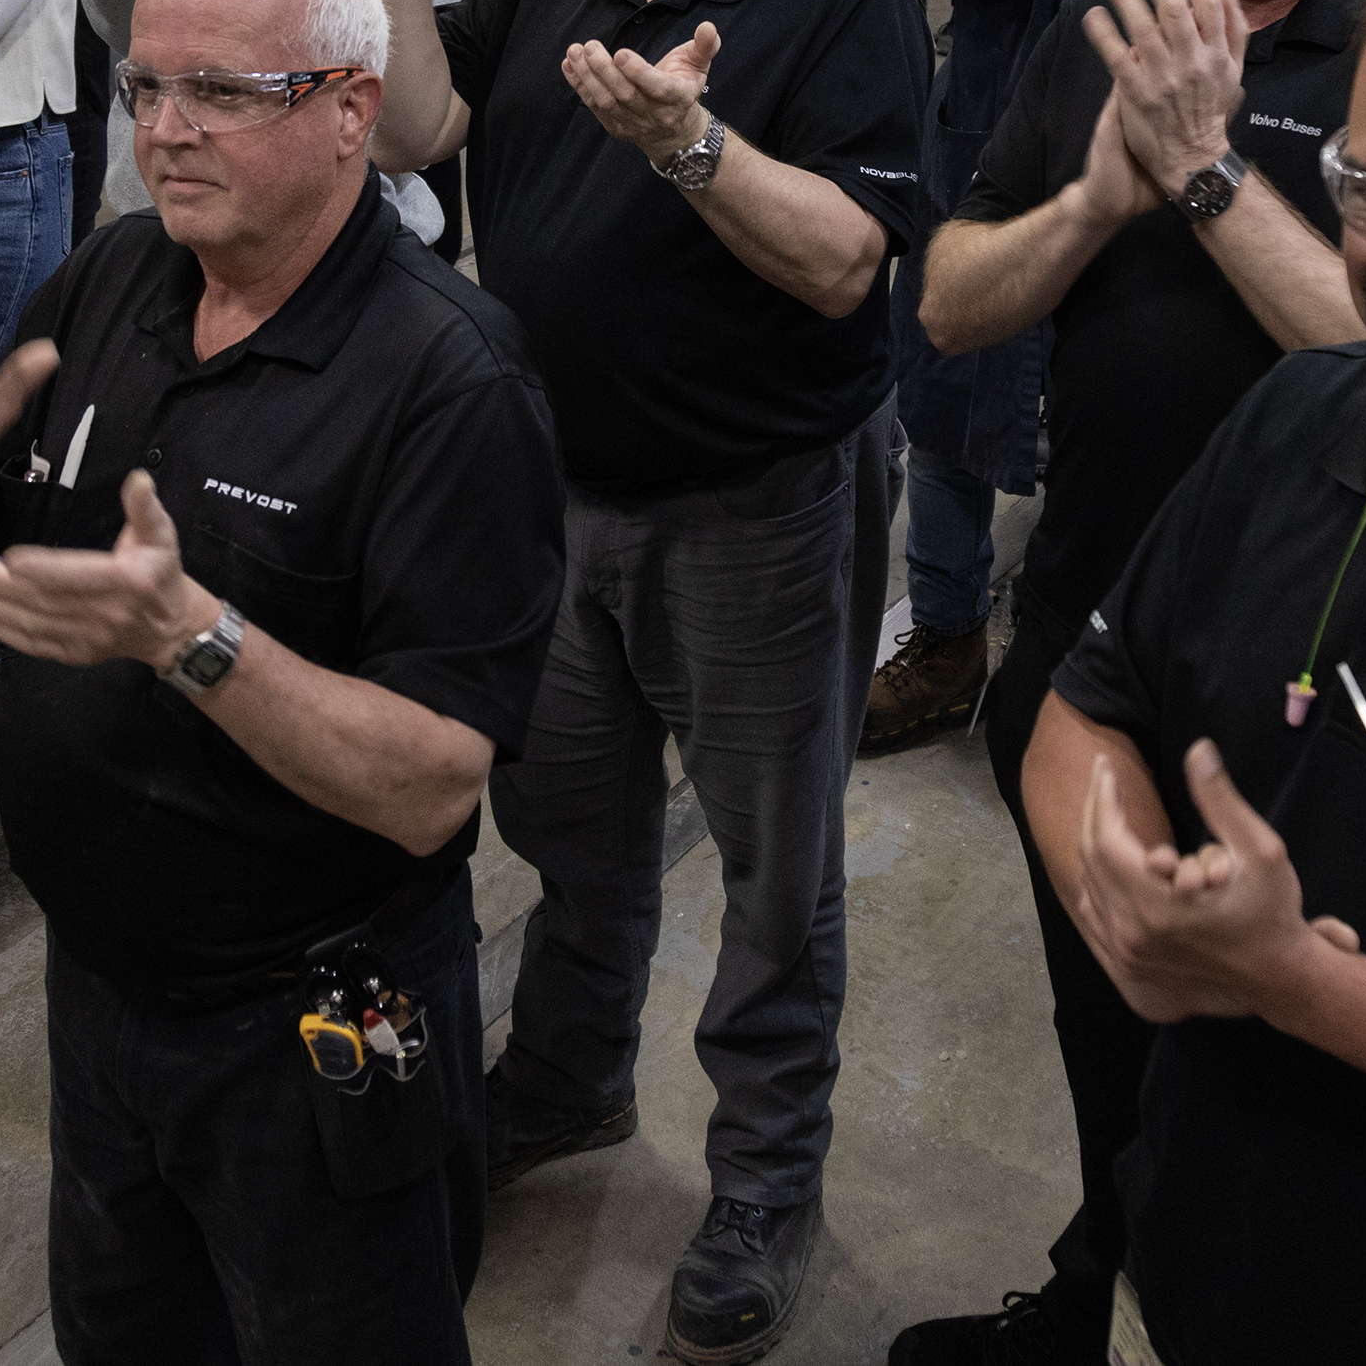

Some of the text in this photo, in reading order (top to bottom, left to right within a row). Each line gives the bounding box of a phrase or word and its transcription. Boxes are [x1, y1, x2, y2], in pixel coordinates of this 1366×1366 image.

[1249, 113, 1322, 137] Volvo Buses
[203, 477, 297, 516] PREVOST
